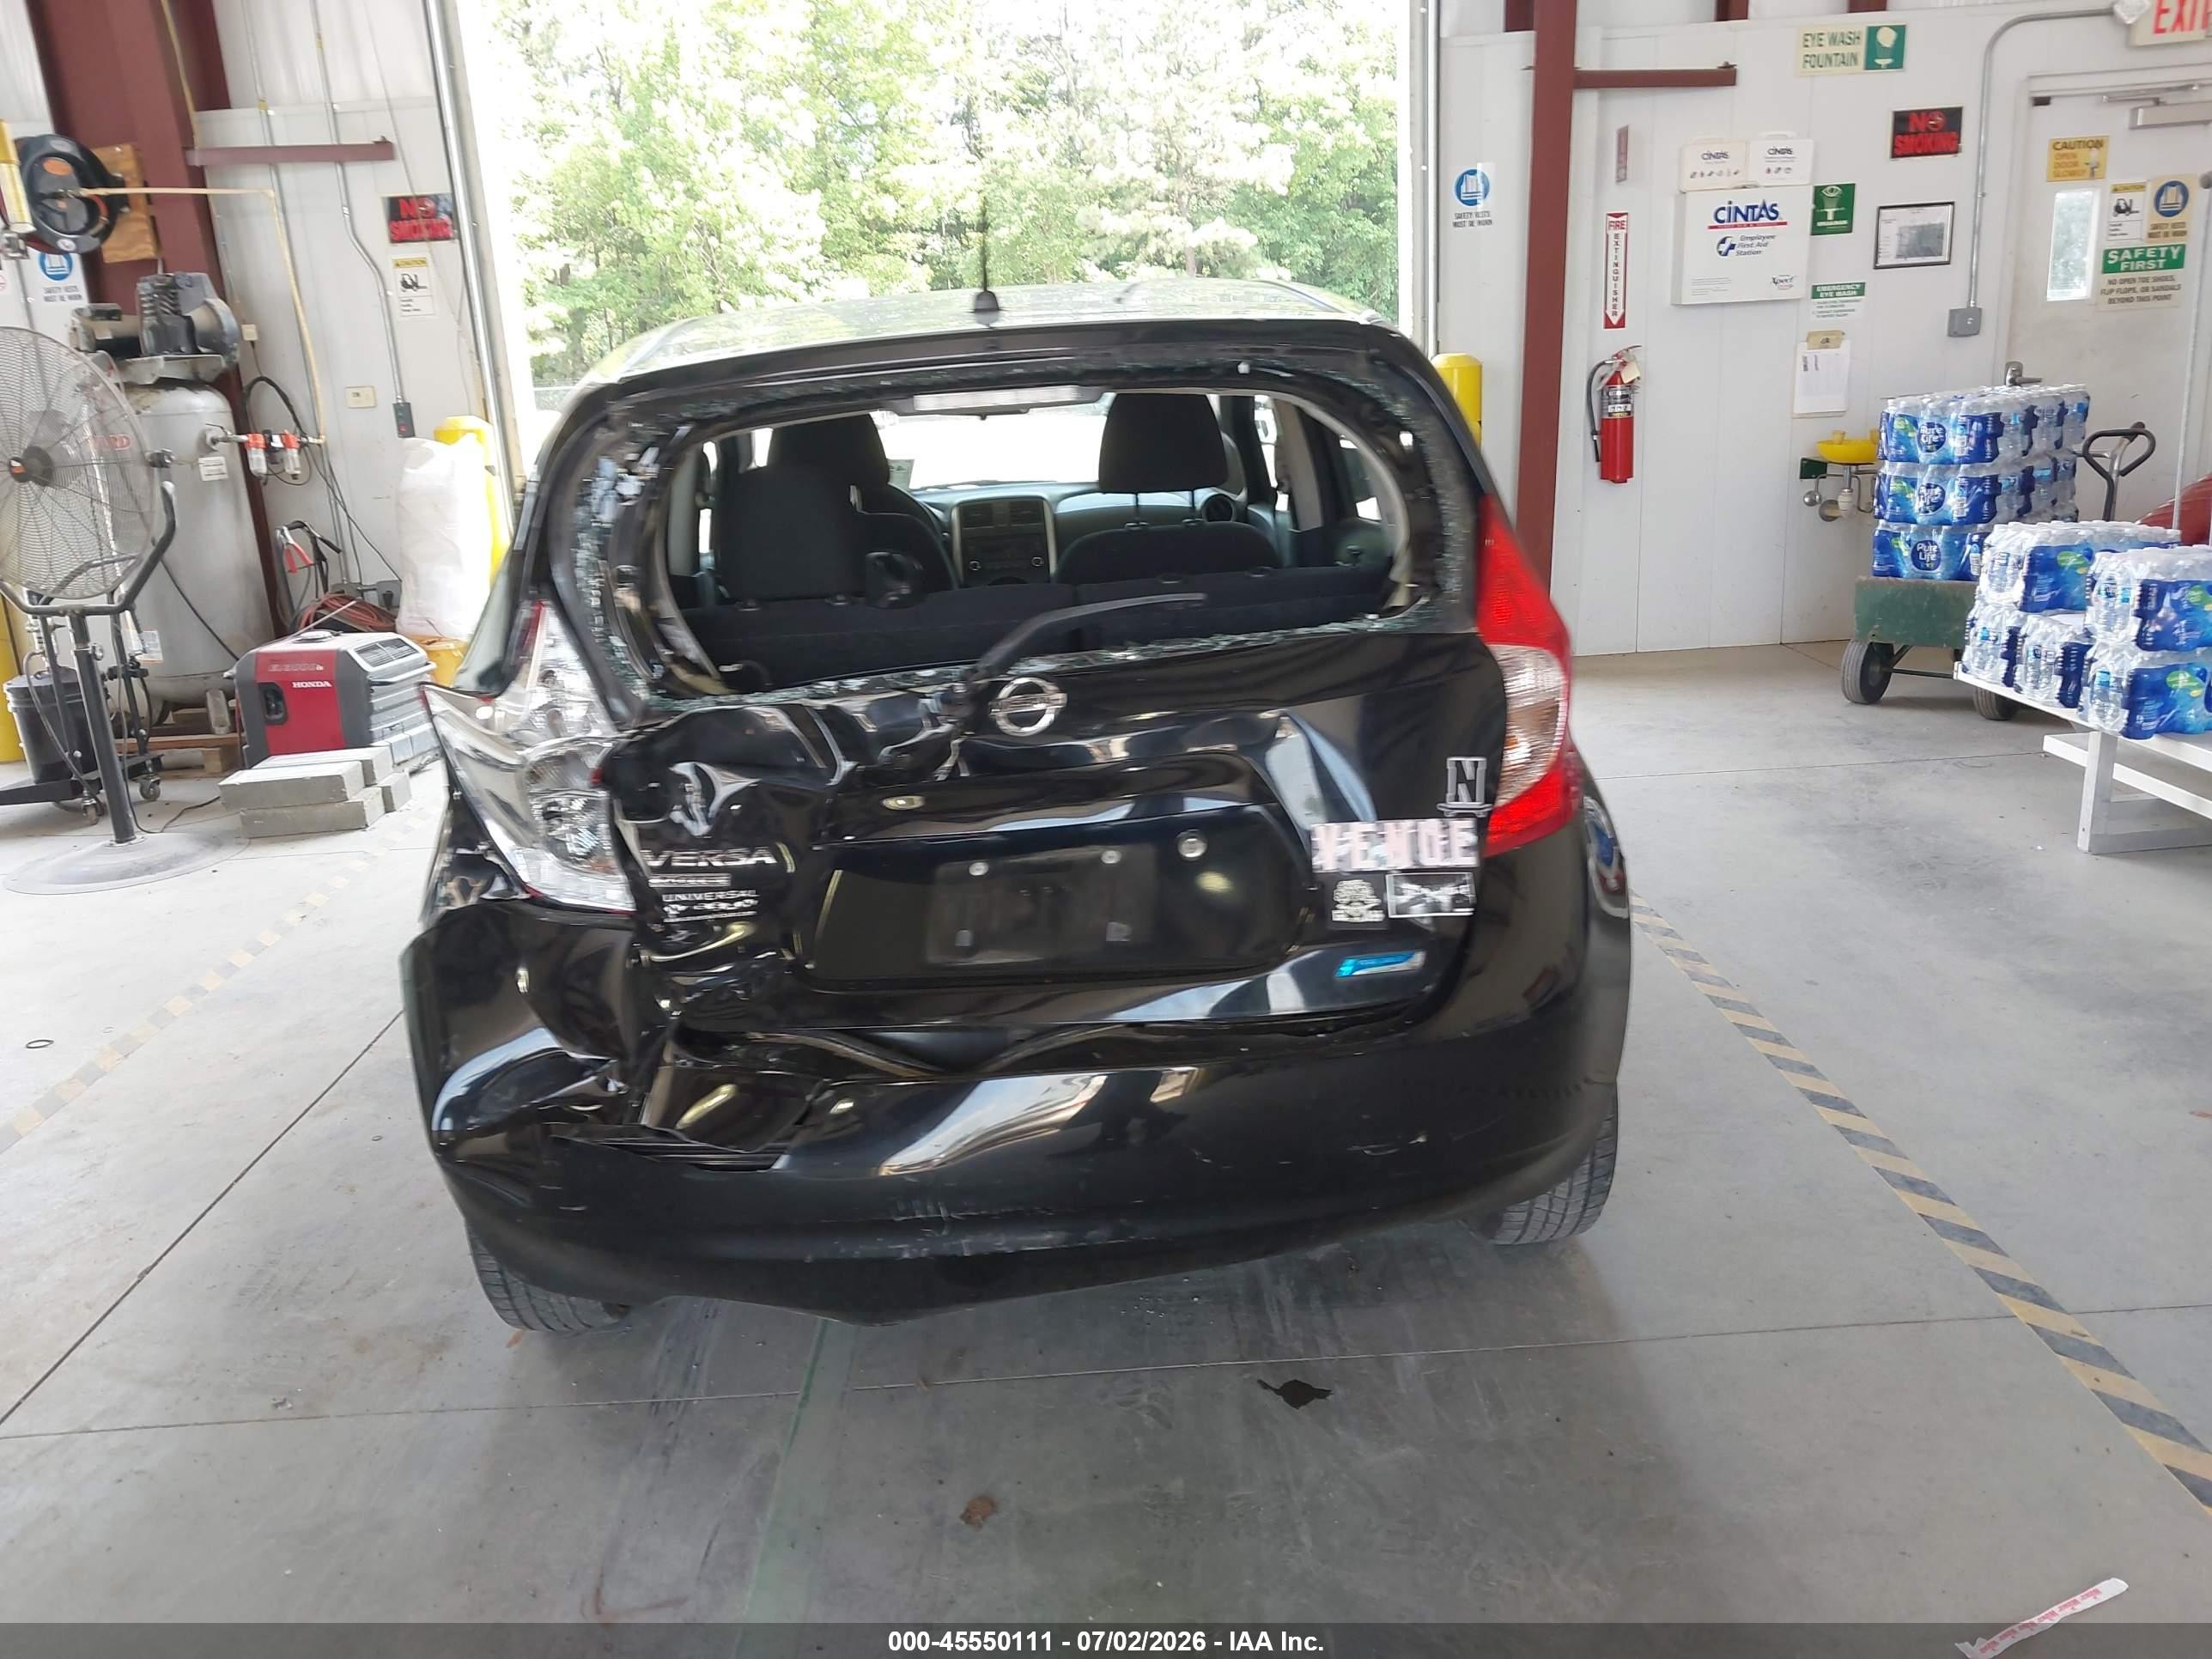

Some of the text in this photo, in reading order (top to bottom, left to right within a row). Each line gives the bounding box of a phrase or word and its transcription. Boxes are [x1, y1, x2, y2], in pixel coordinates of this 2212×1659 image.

[1802, 31, 1861, 48] EYE WASH
[1802, 52, 1858, 69] FOUNTAIN
[1909, 110, 1945, 132] NO
[1894, 131, 1958, 155] SMOKING
[2053, 139, 2103, 150] CAUTION
[1607, 220, 1626, 230] FIRE
[2107, 246, 2181, 264] SAFETY
[2120, 258, 2166, 271] FIRST
[2151, 283, 2181, 292] SANDALS
[640, 847, 777, 866] VERSA
